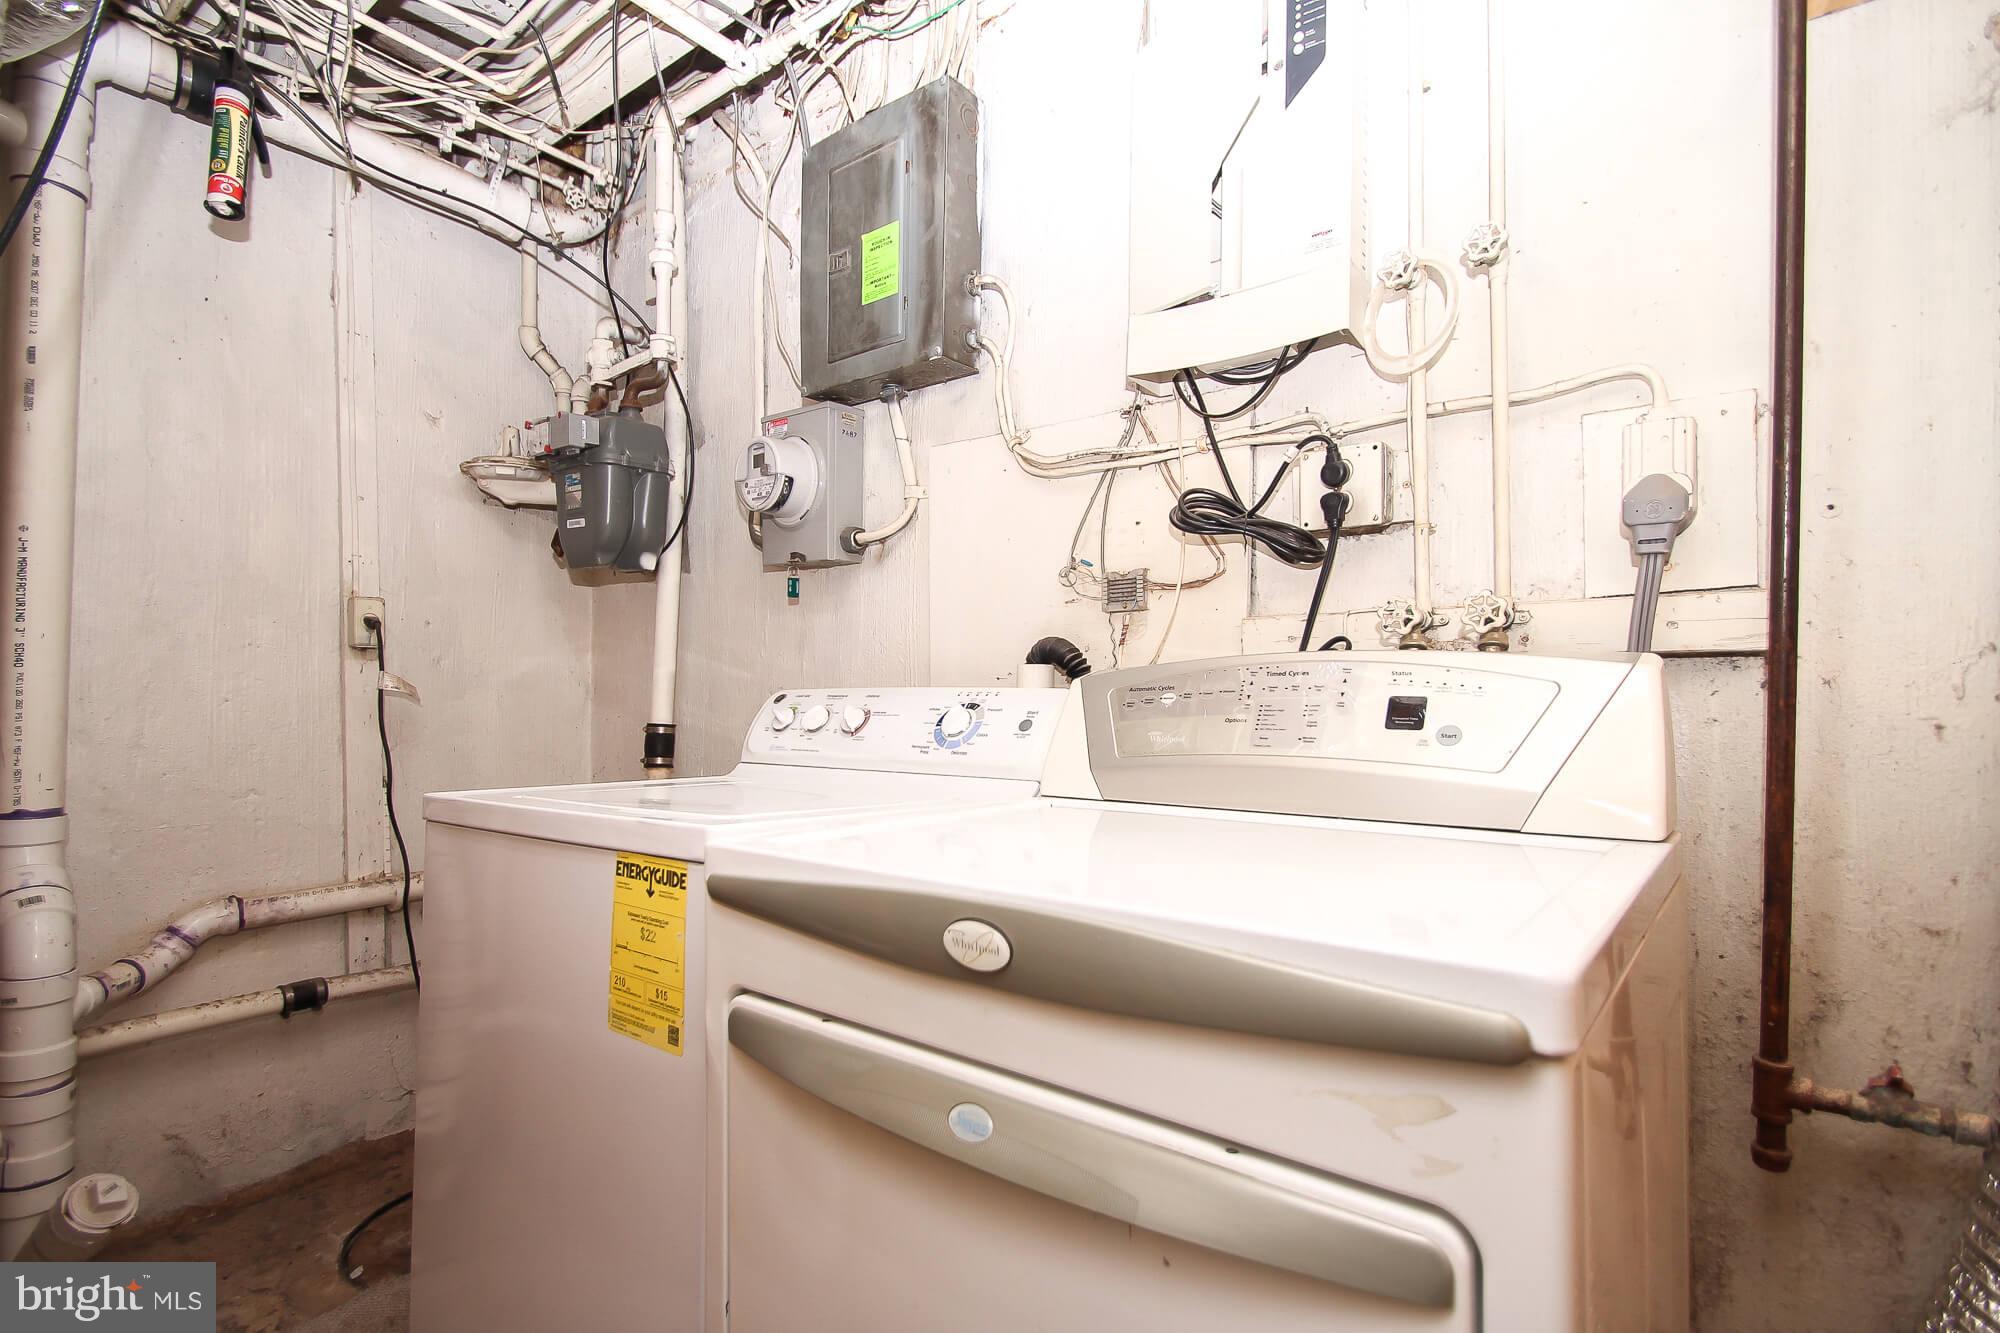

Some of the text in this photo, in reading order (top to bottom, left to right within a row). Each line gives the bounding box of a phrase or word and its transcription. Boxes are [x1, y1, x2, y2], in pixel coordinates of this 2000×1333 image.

[30, 279, 40, 295] 2007
[18, 536, 29, 553] J-M
[15, 556, 28, 623] MANUFACTURING
[13, 642, 25, 668] SCH40
[616, 860, 688, 891] ENERGYGUIDE
[640, 926, 657, 944] $22
[951, 935, 1000, 958] Whirlpool
[614, 975, 626, 988] 210
[655, 987, 669, 1002] $15
